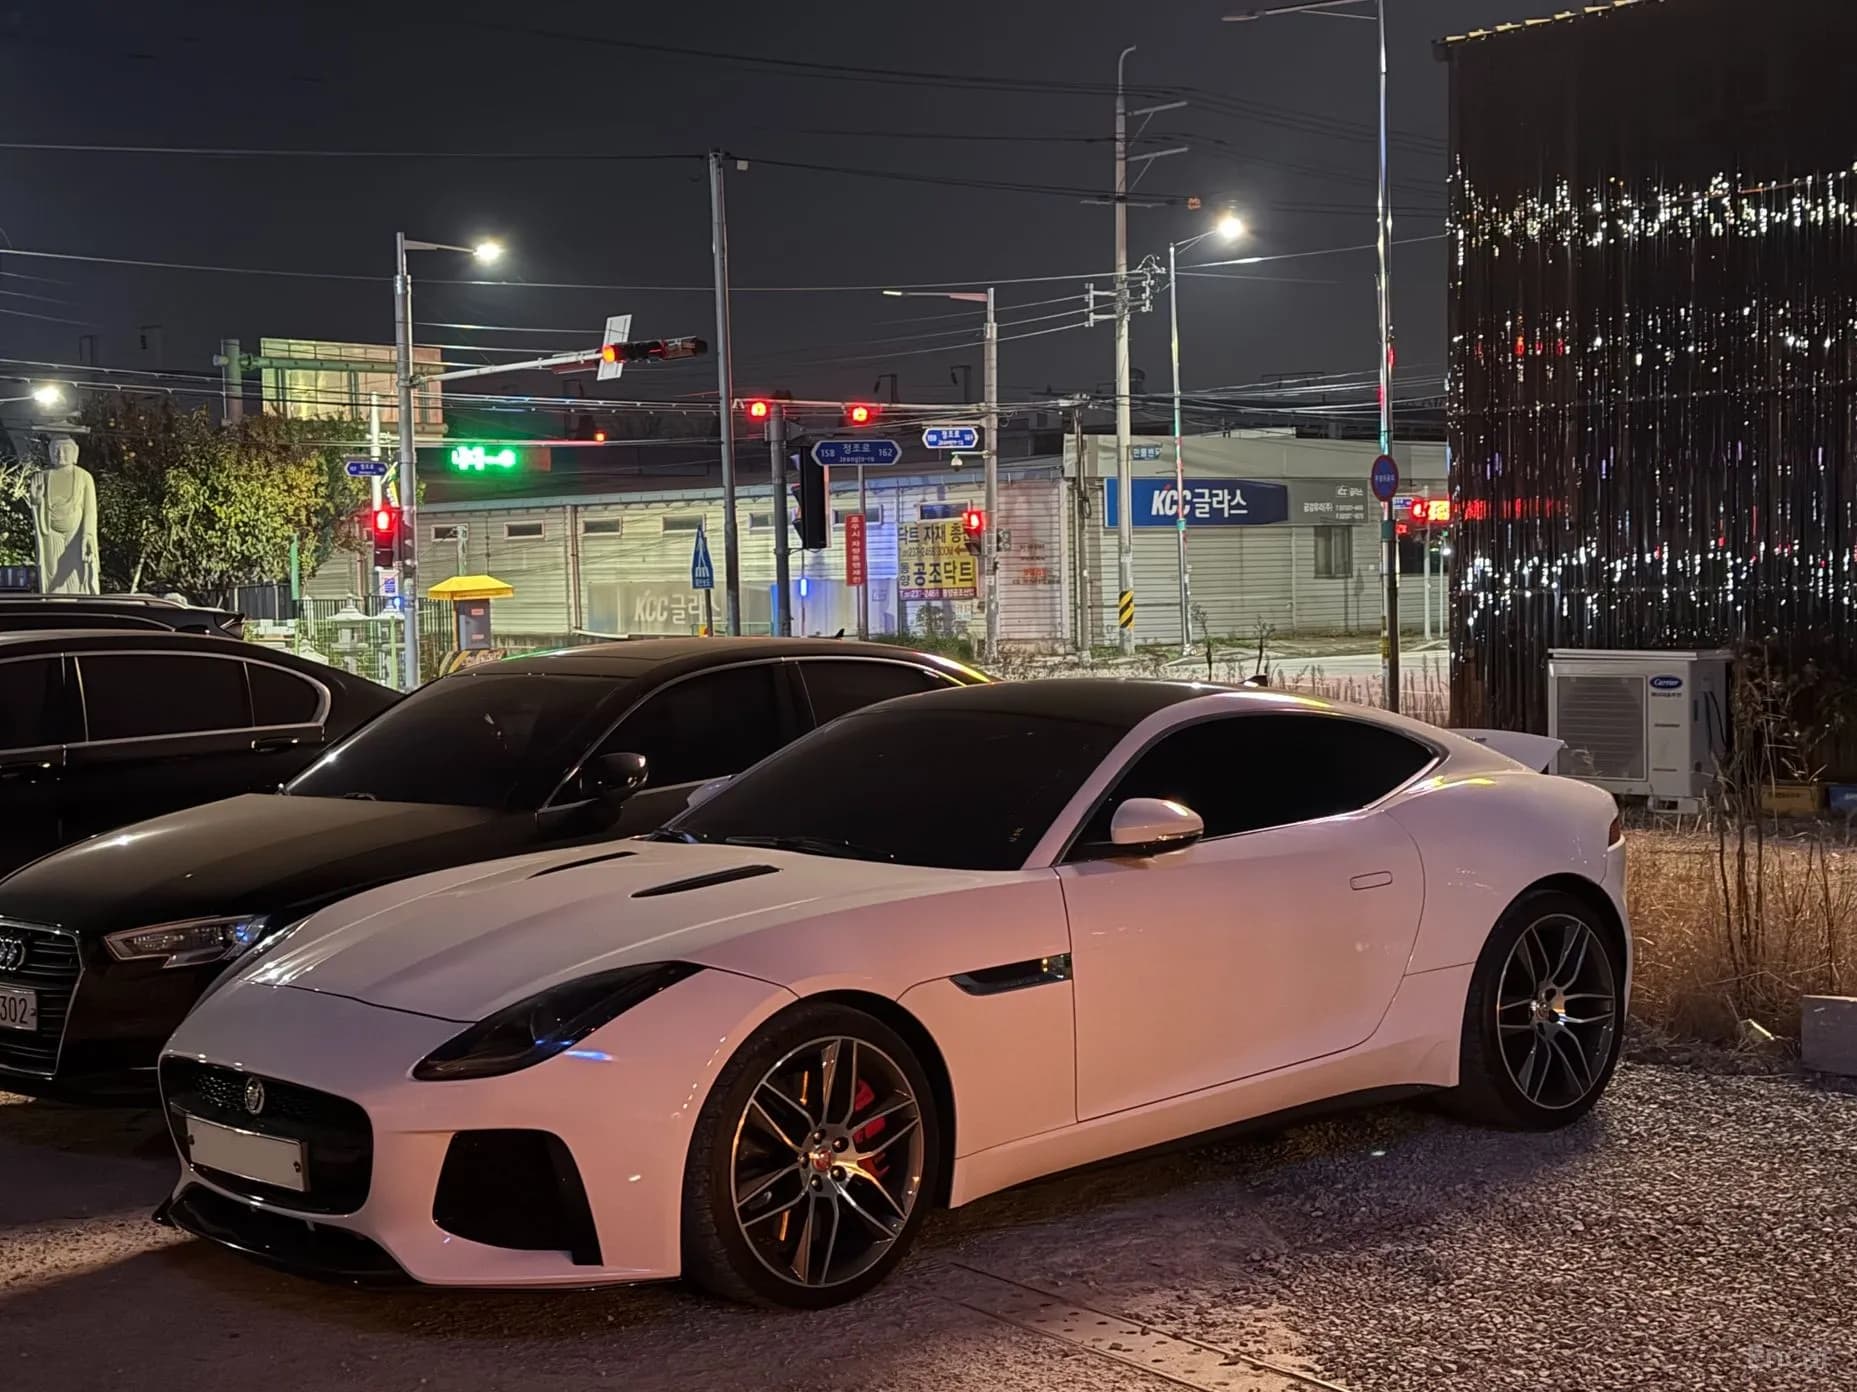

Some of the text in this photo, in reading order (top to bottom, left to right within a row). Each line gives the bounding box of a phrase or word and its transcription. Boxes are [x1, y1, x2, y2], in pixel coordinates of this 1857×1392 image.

[842, 443, 871, 454] 정조로
[878, 448, 893, 457] 162
[913, 560, 973, 586] 공조닥트
